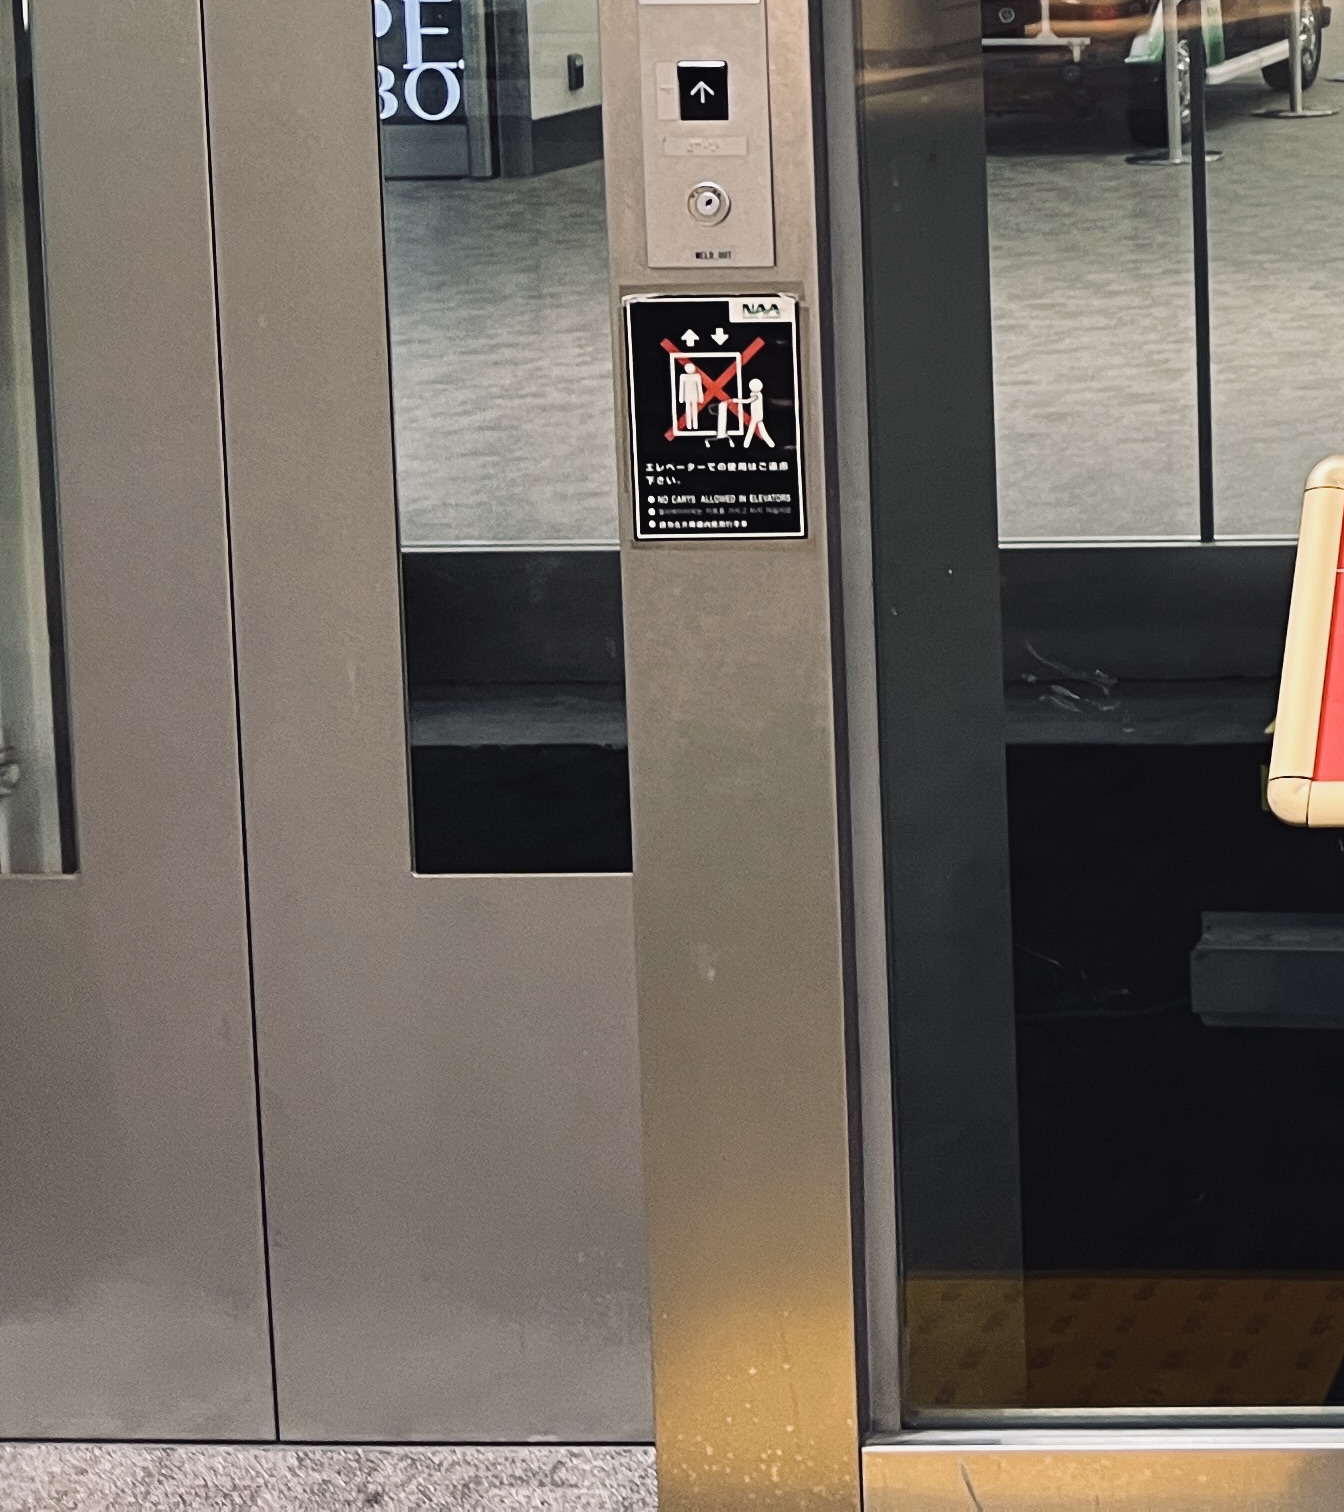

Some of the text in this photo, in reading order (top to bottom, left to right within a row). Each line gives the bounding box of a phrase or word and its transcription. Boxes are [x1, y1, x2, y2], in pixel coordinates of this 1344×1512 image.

[657, 494, 669, 504] NO
[700, 494, 736, 504] ALLOWED
[749, 493, 792, 503] ELEVATORS
